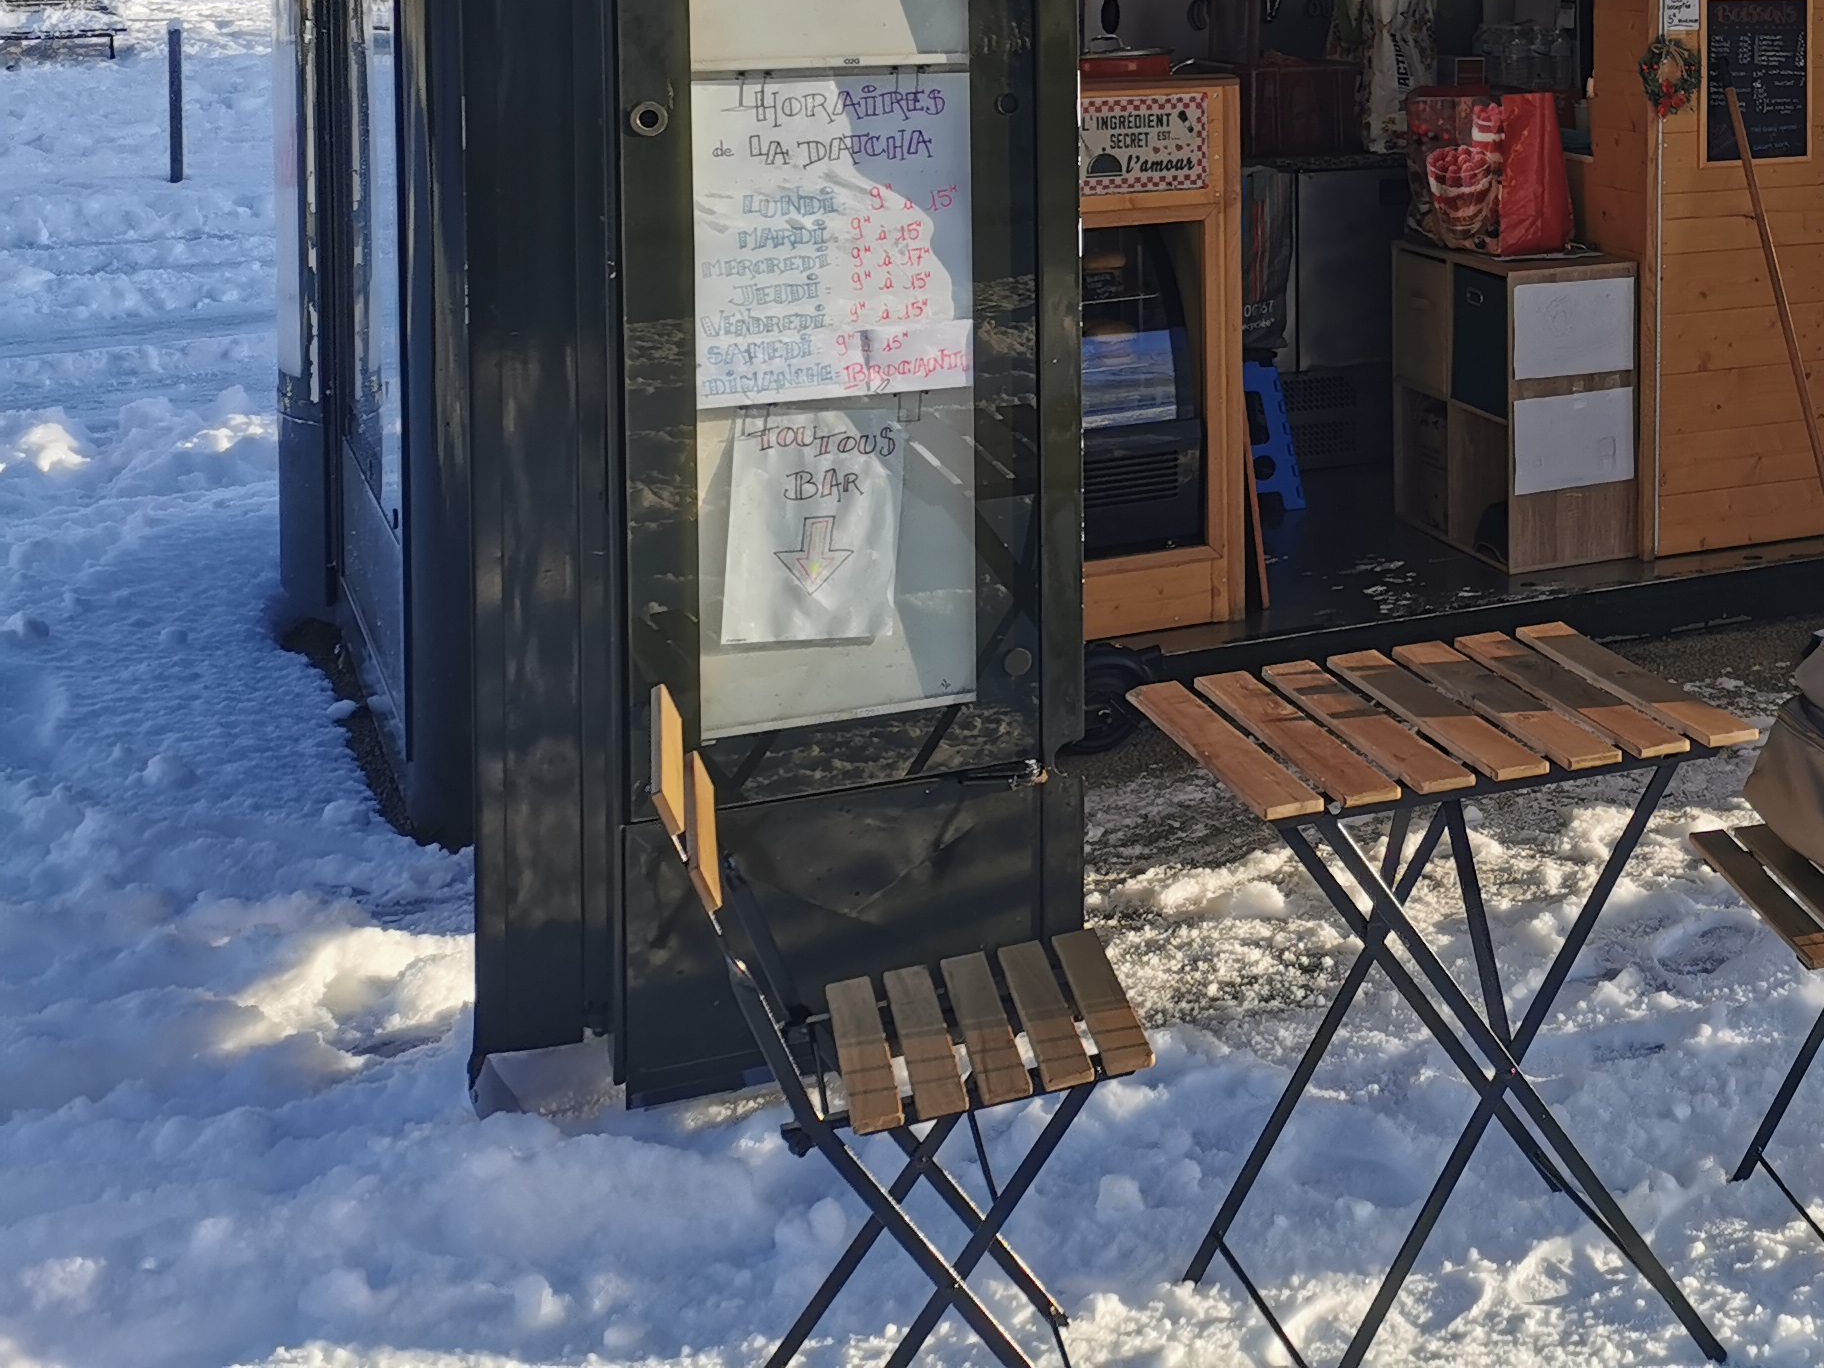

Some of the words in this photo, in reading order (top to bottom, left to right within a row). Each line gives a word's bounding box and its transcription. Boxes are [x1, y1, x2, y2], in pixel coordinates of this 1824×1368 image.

[1082, 112, 1172, 132] L'INGRÉDIENT
[712, 139, 735, 158] de
[1110, 132, 1150, 150] SECRET
[1125, 154, 1196, 174] l'amour
[747, 425, 896, 458] TOUTOUS
[783, 467, 864, 503] BAR
